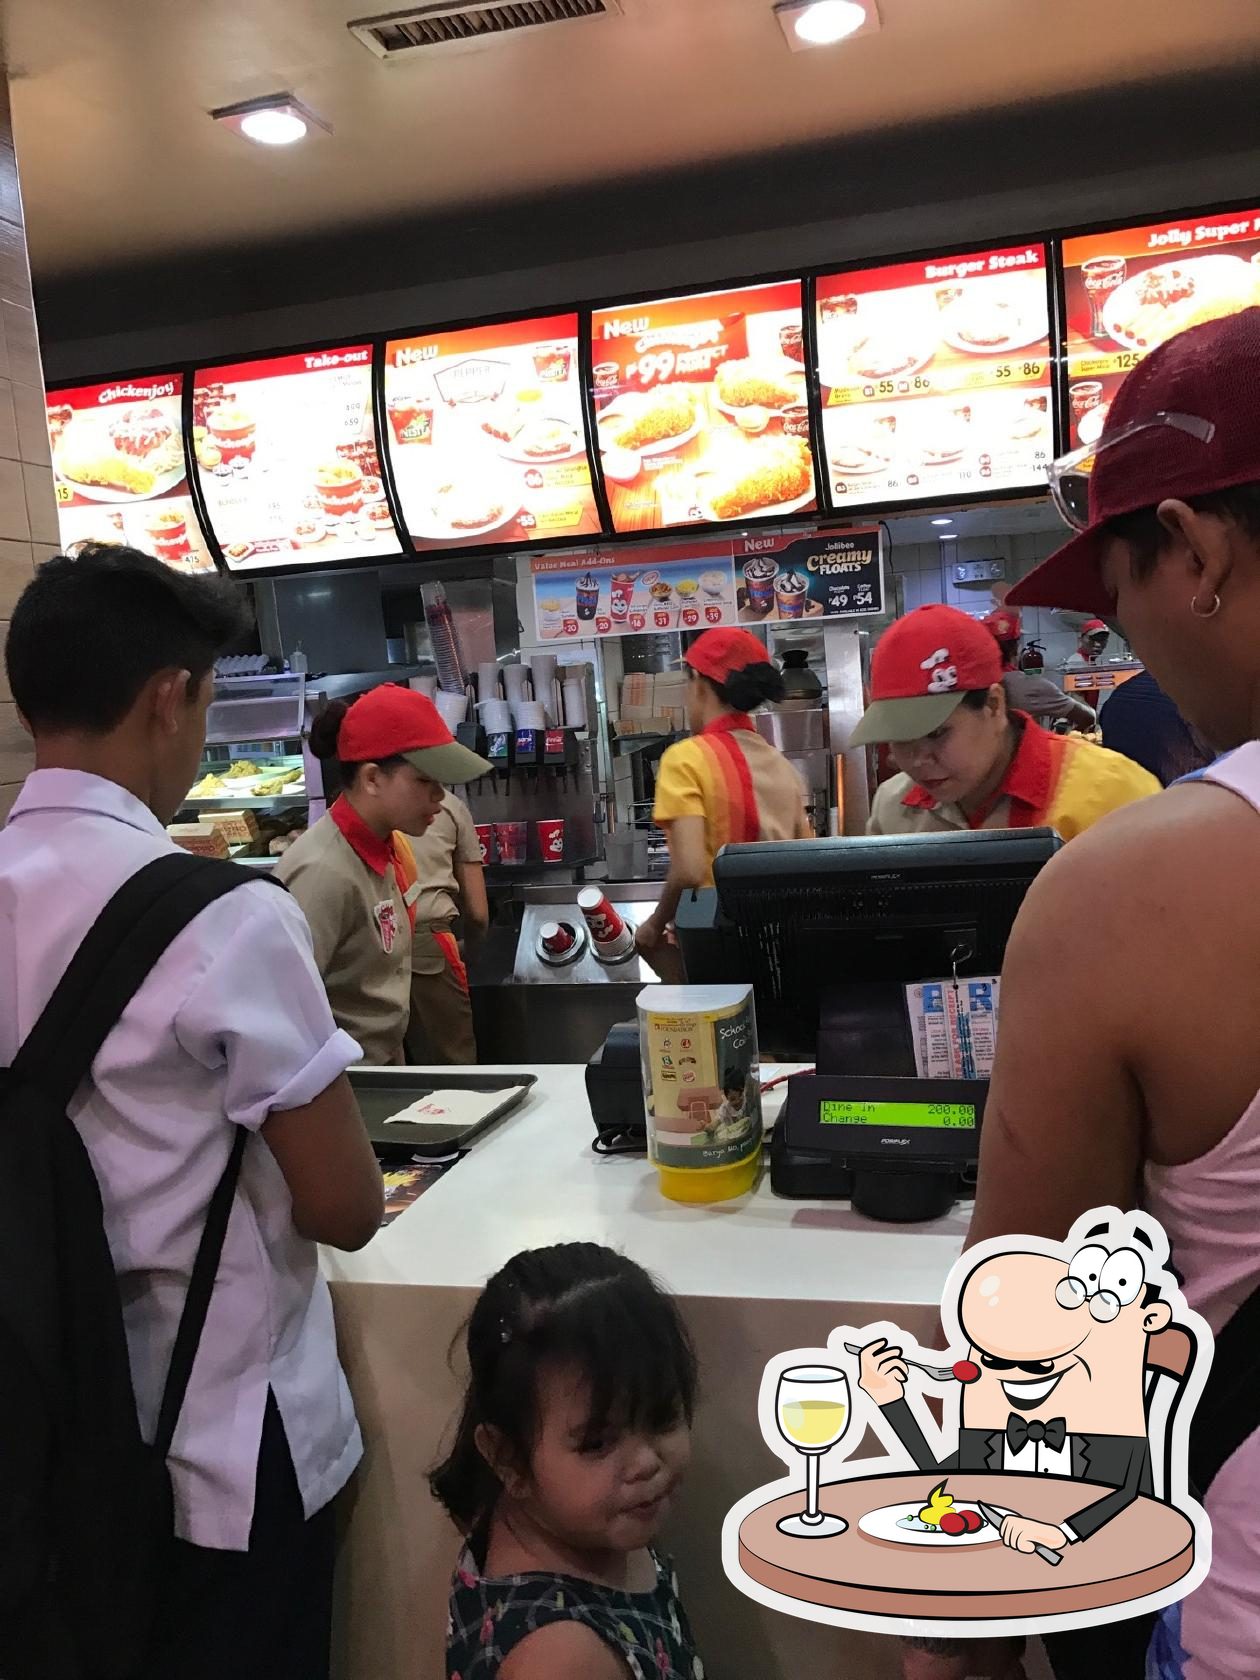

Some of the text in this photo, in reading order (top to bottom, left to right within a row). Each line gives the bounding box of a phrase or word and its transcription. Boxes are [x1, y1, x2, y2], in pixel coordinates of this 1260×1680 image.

[1148, 228, 1191, 247] Jolly
[1194, 220, 1249, 240] Super
[925, 249, 1039, 279] Burger Steak
[603, 317, 650, 340] New
[304, 350, 368, 369] Take-out
[396, 344, 438, 367] New
[995, 365, 1011, 377] 55
[1023, 362, 1040, 375] 86
[98, 381, 174, 404] Chickenjoy
[879, 380, 894, 393] 55
[744, 538, 775, 553] New
[825, 542, 855, 551] Jollibee
[806, 550, 872, 571] Creamy
[820, 562, 862, 576] FLOATS
[823, 1101, 853, 1112] Dine
[928, 1104, 975, 1115] 200.00
[823, 1112, 975, 1126] Change 0.00
